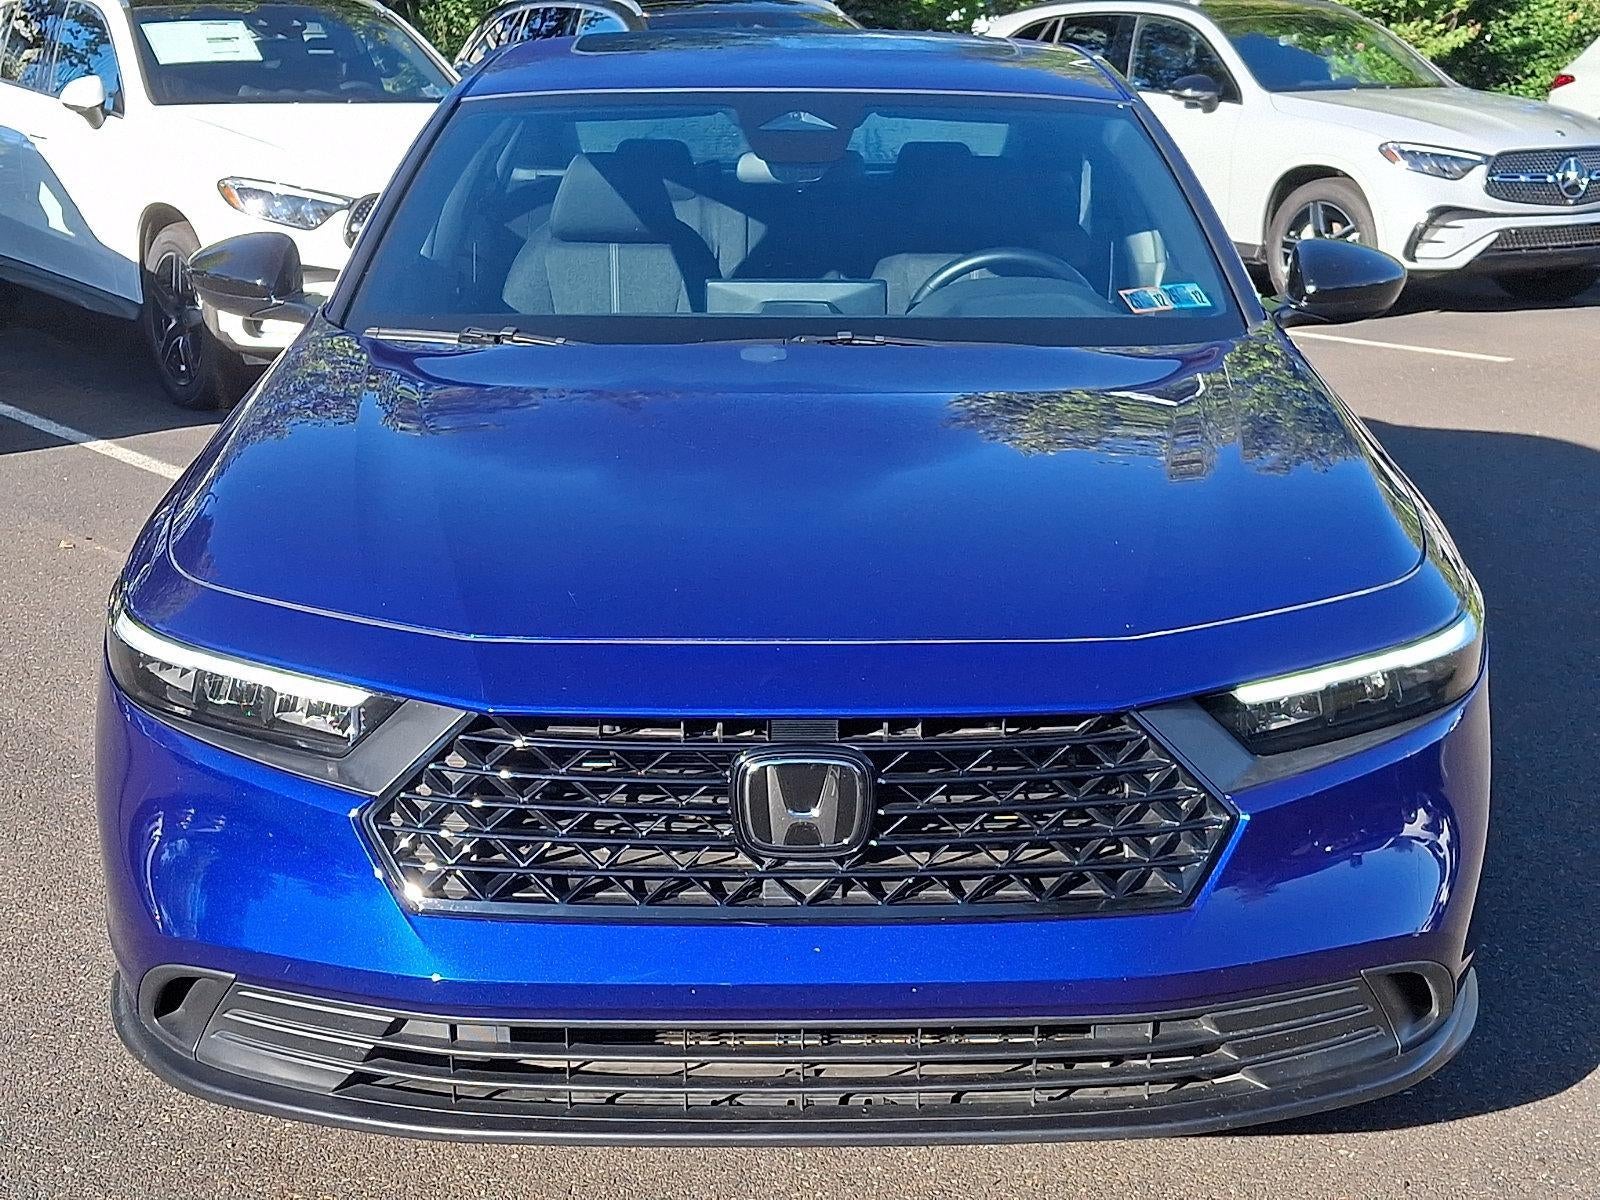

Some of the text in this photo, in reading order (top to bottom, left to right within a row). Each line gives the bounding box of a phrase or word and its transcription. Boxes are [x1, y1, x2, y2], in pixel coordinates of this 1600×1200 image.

[1152, 293, 1168, 306] 12
[1191, 289, 1207, 304] 12
[766, 765, 841, 845] H
